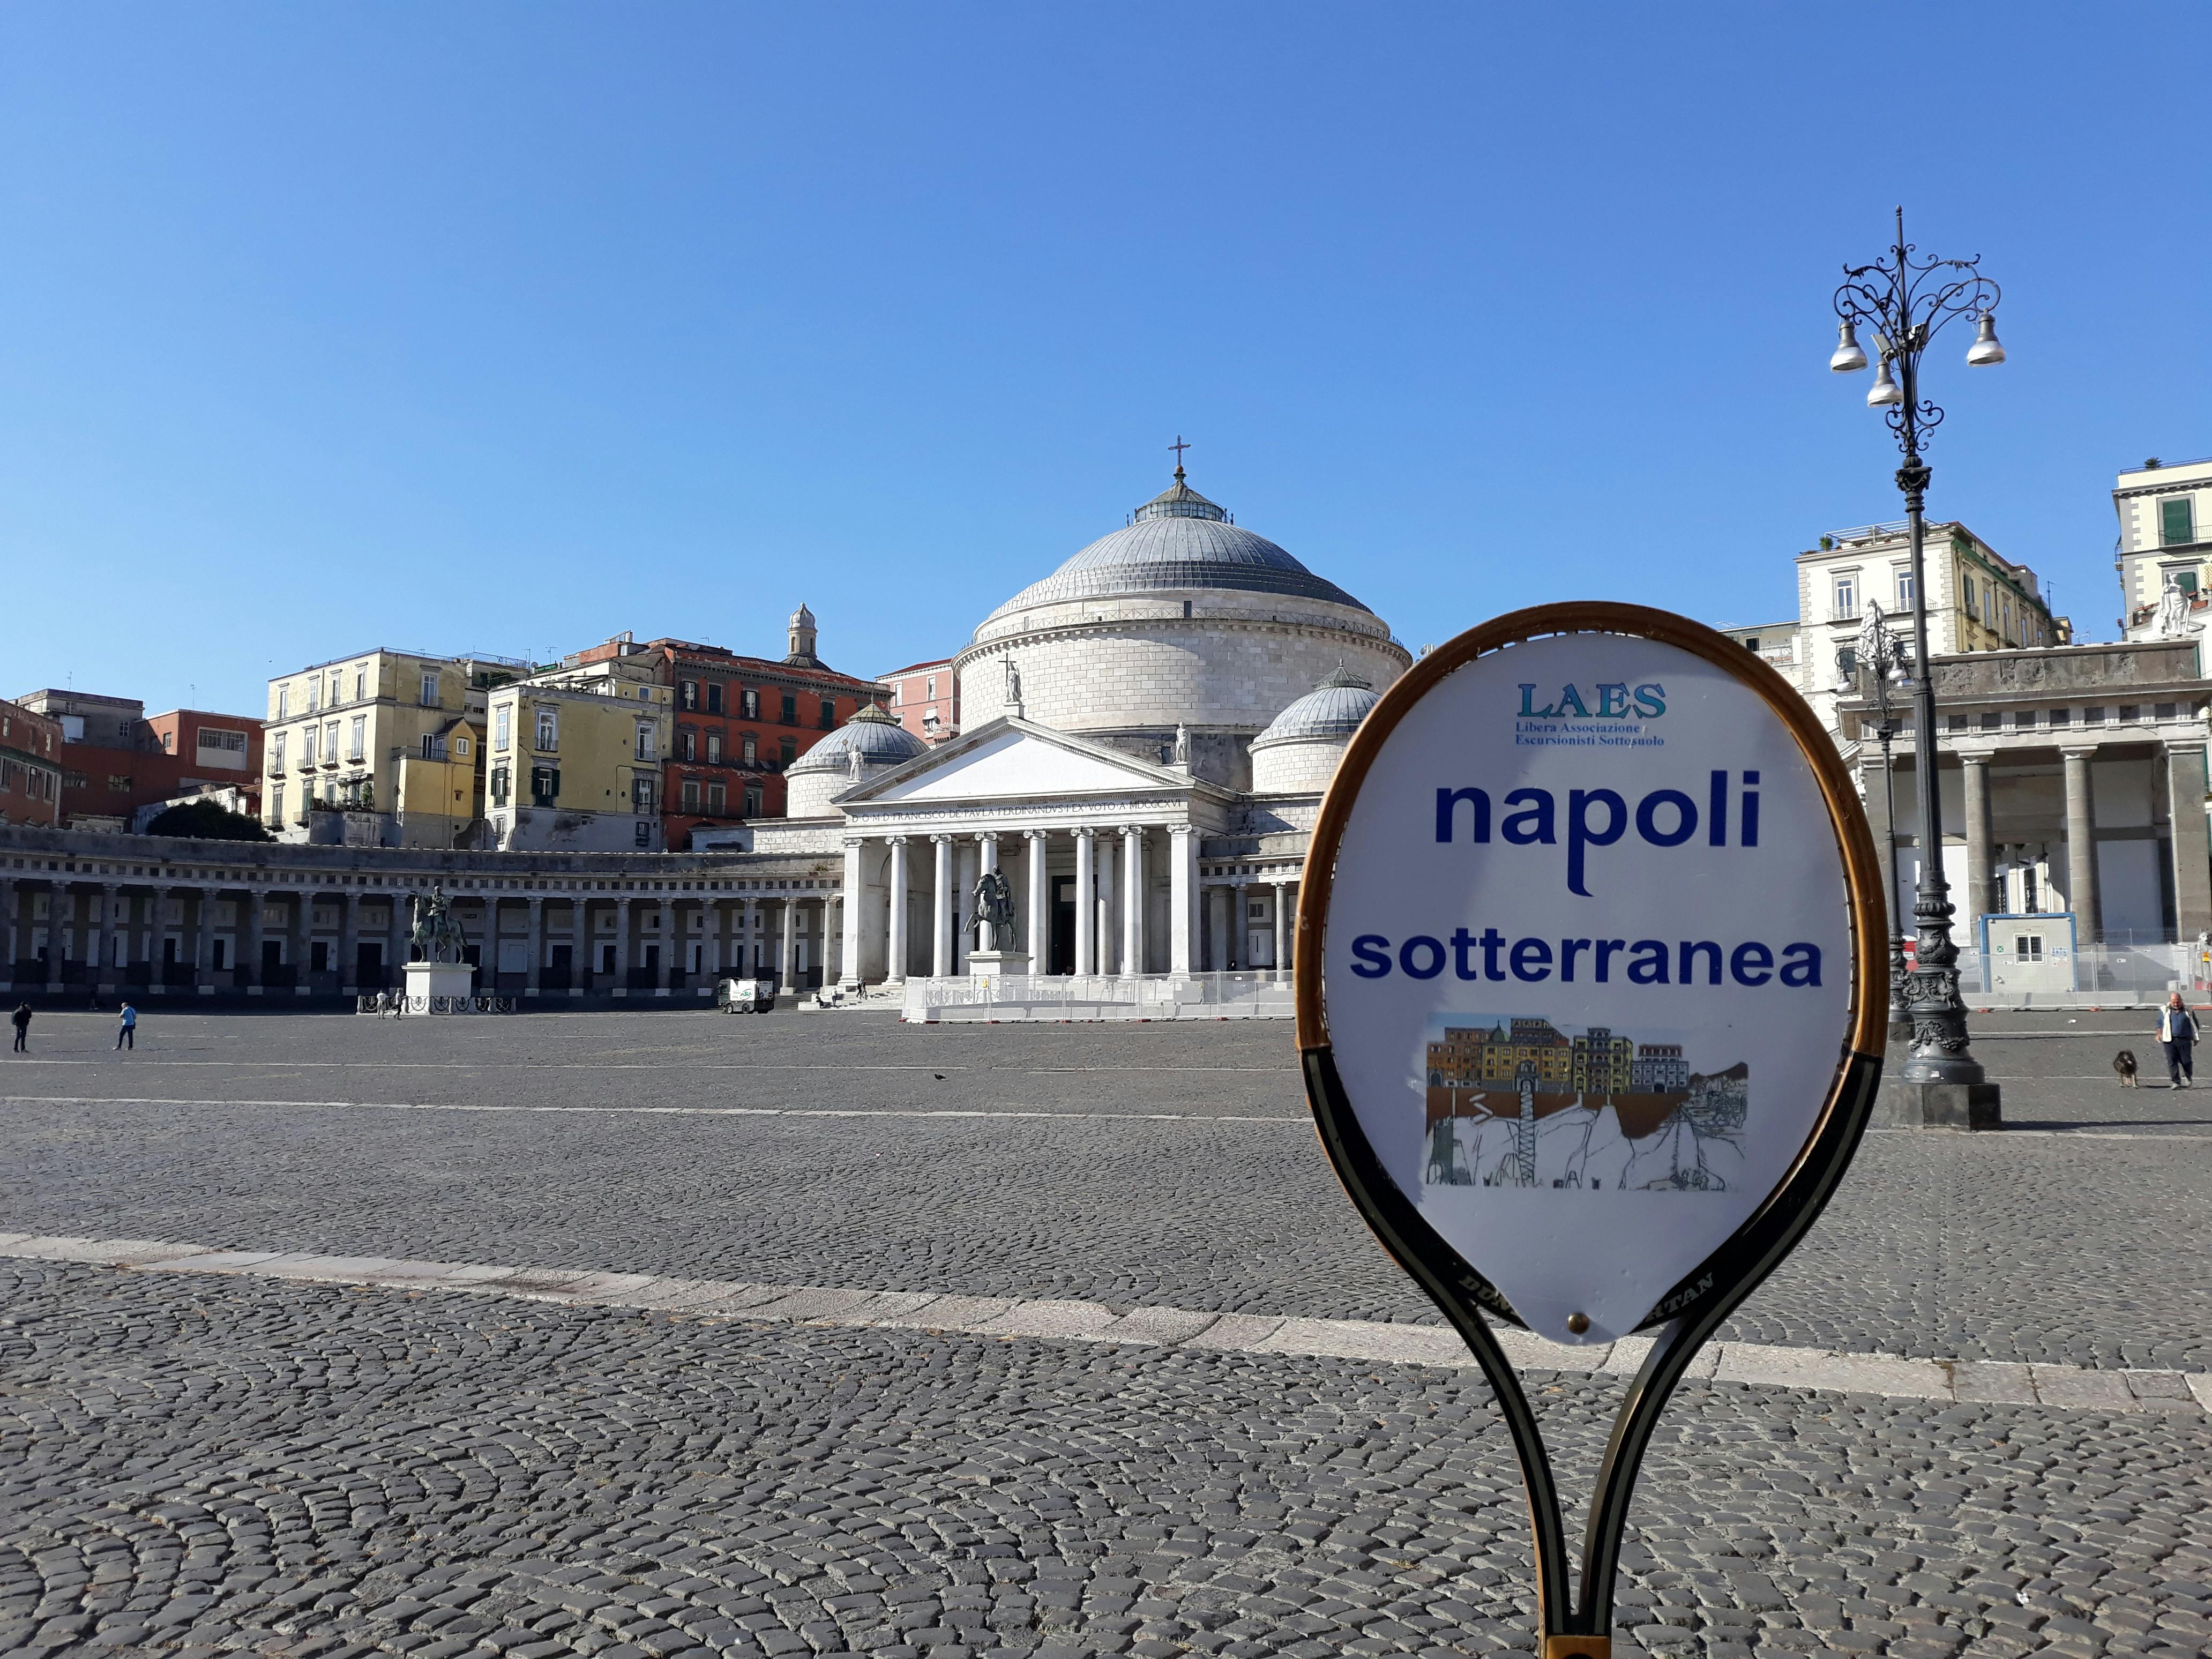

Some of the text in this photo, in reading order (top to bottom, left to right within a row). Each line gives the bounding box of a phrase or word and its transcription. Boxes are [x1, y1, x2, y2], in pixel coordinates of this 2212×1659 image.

[1517, 683, 1667, 719] LAES
[1515, 734, 1664, 746] Escursionisti Sottosuolo
[1516, 722, 1640, 733] Libera Associazione
[1434, 770, 1760, 898] napoli
[1349, 927, 1823, 988] sotterranea
